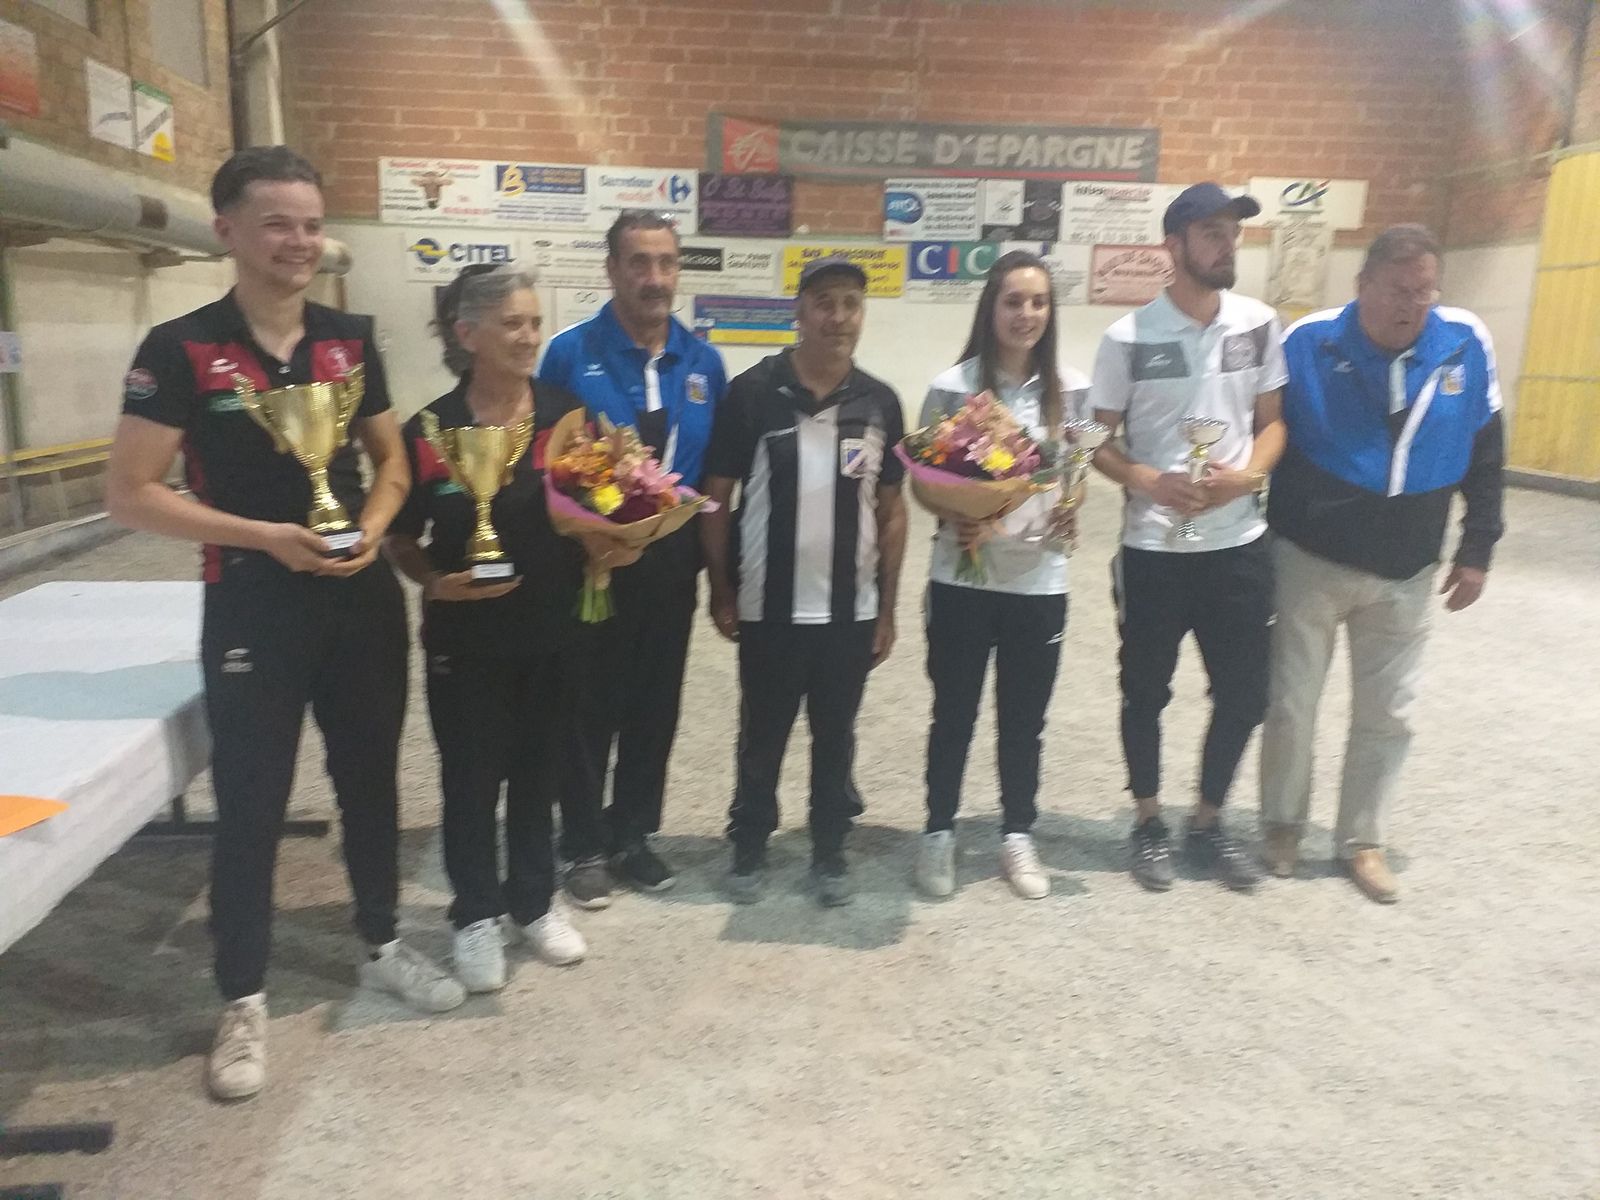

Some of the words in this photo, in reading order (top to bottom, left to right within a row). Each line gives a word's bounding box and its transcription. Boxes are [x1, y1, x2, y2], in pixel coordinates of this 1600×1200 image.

[790, 130, 918, 164] CAISSE
[934, 133, 1146, 169] D'EPARGNE
[448, 243, 513, 263] CITEL
[916, 244, 993, 276] CIC
